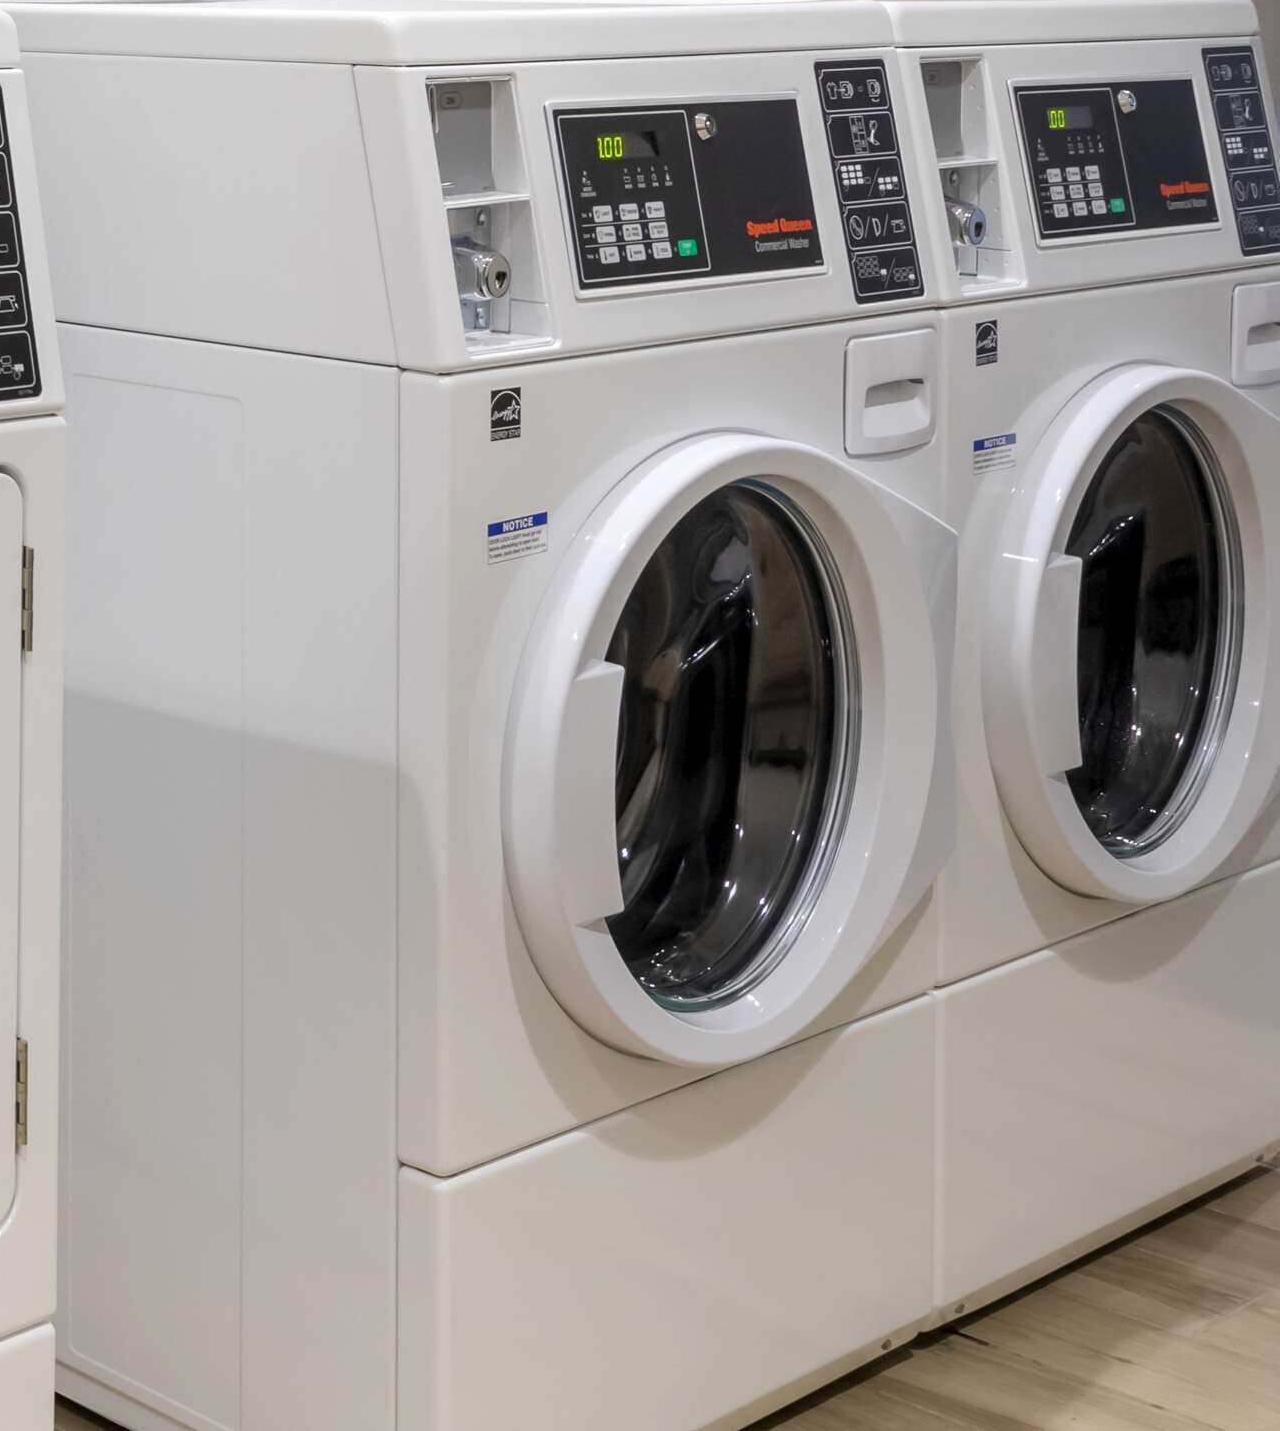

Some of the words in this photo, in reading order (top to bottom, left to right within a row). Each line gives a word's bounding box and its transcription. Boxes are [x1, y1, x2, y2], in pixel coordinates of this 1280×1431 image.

[746, 219, 780, 238] Speed
[780, 217, 813, 233] Queen
[503, 517, 534, 533] NOTICE
